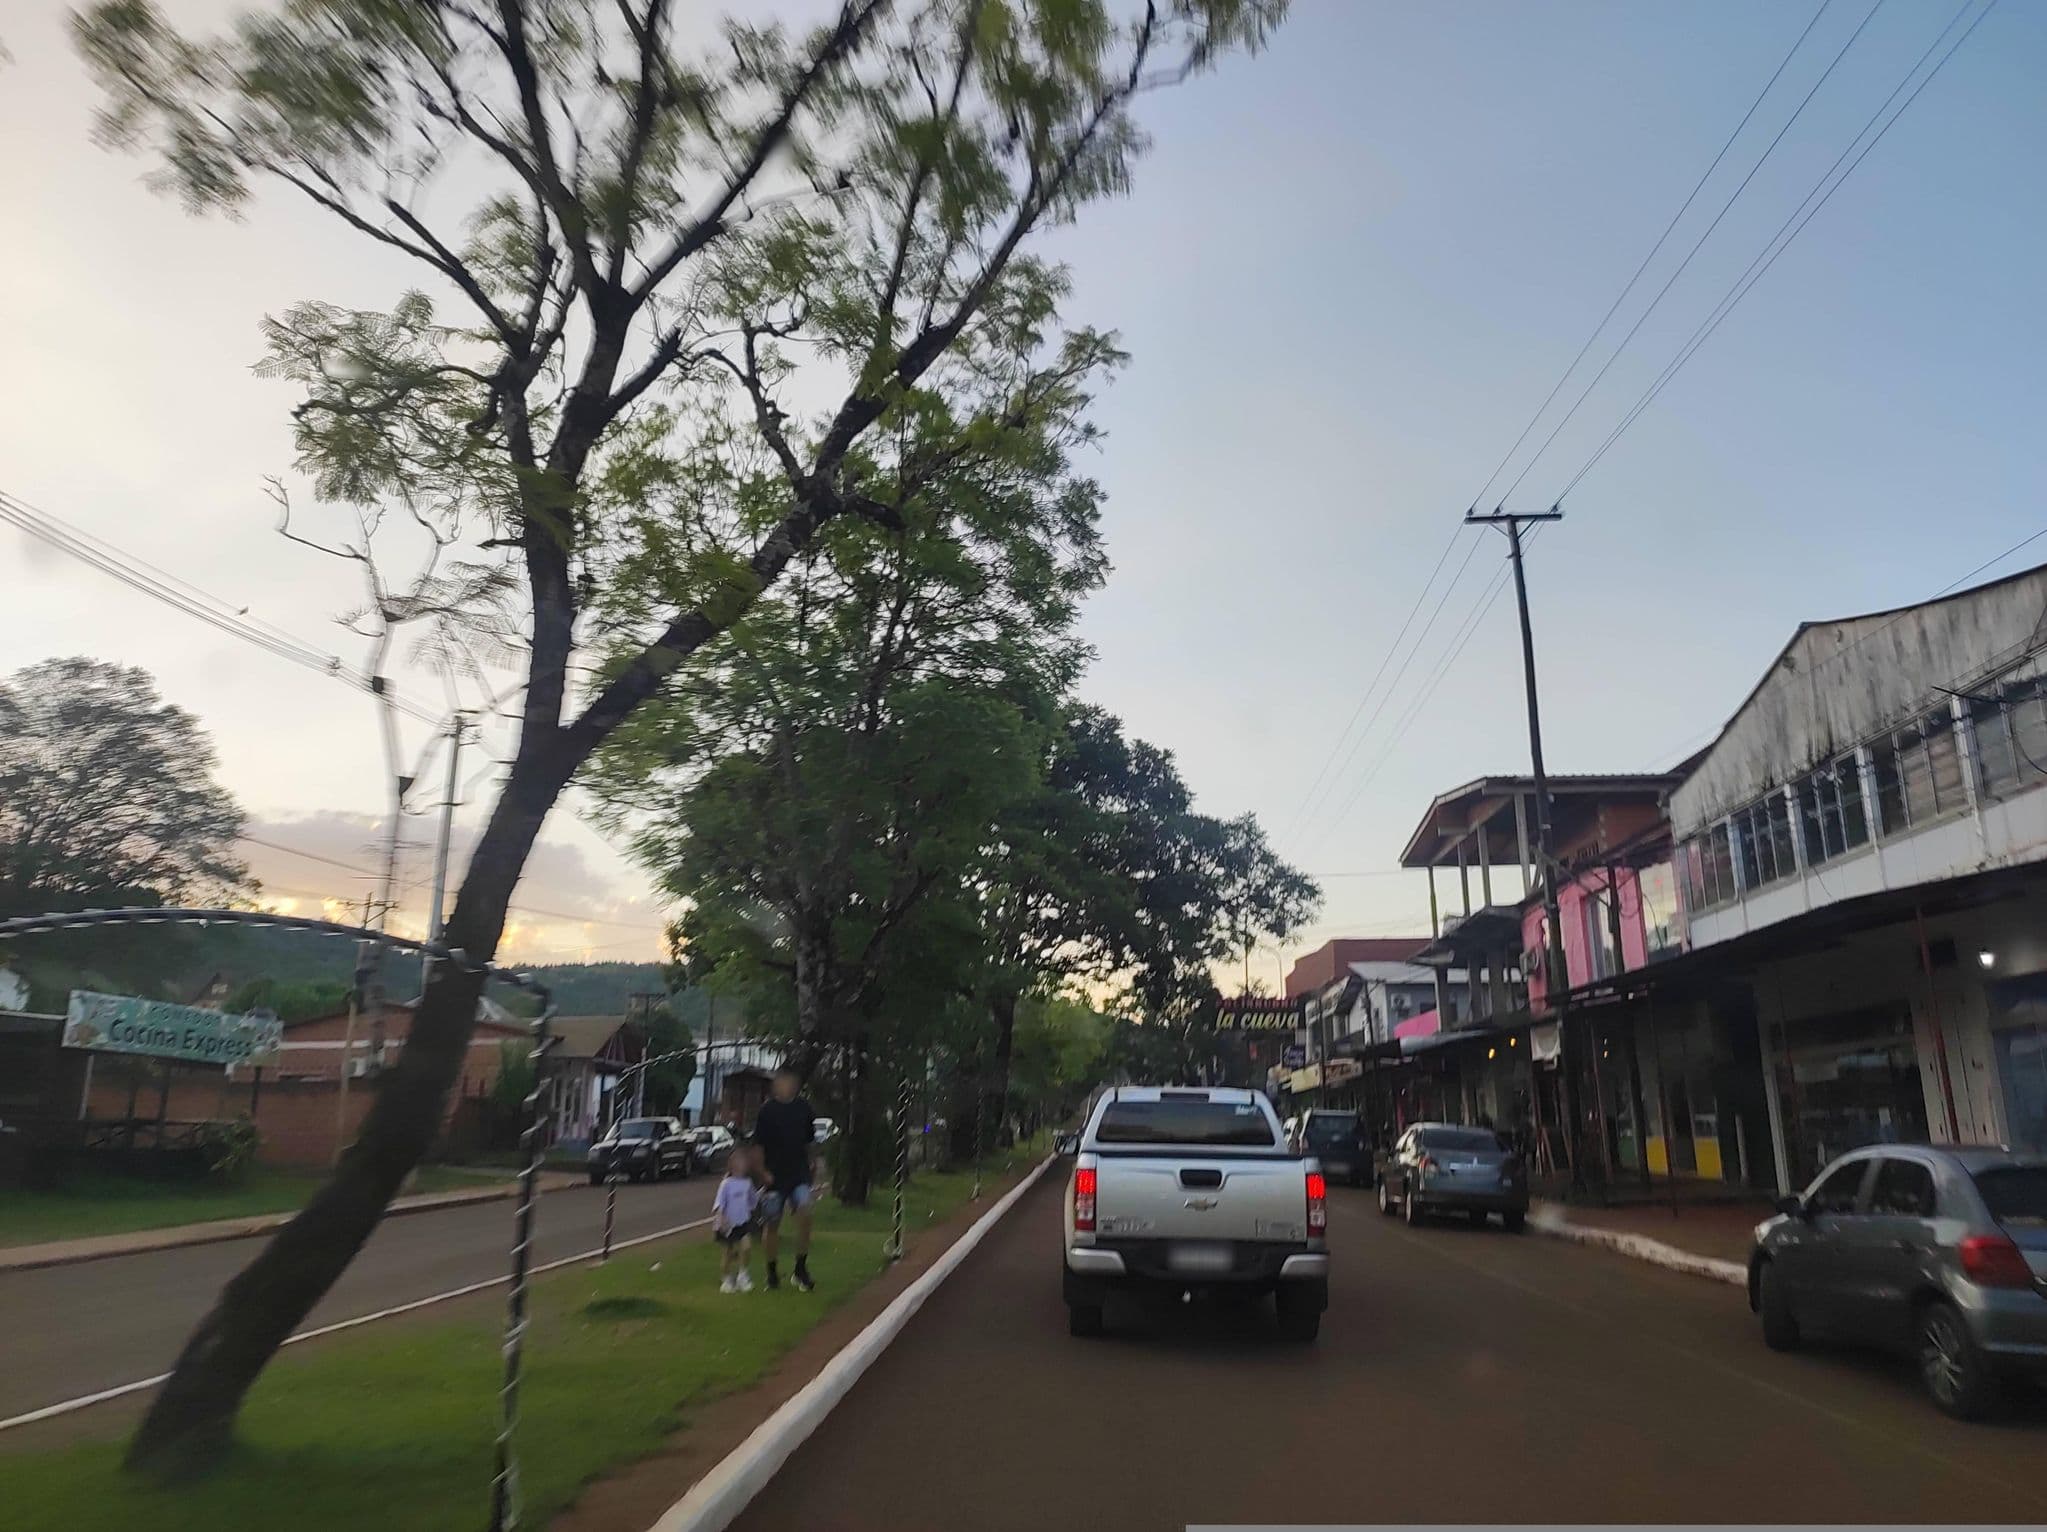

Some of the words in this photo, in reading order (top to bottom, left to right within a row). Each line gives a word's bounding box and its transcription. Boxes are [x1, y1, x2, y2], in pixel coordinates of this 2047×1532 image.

[1240, 1012, 1299, 1030] cueva
[109, 1018, 177, 1047] Cocina
[182, 1028, 251, 1057] Express
